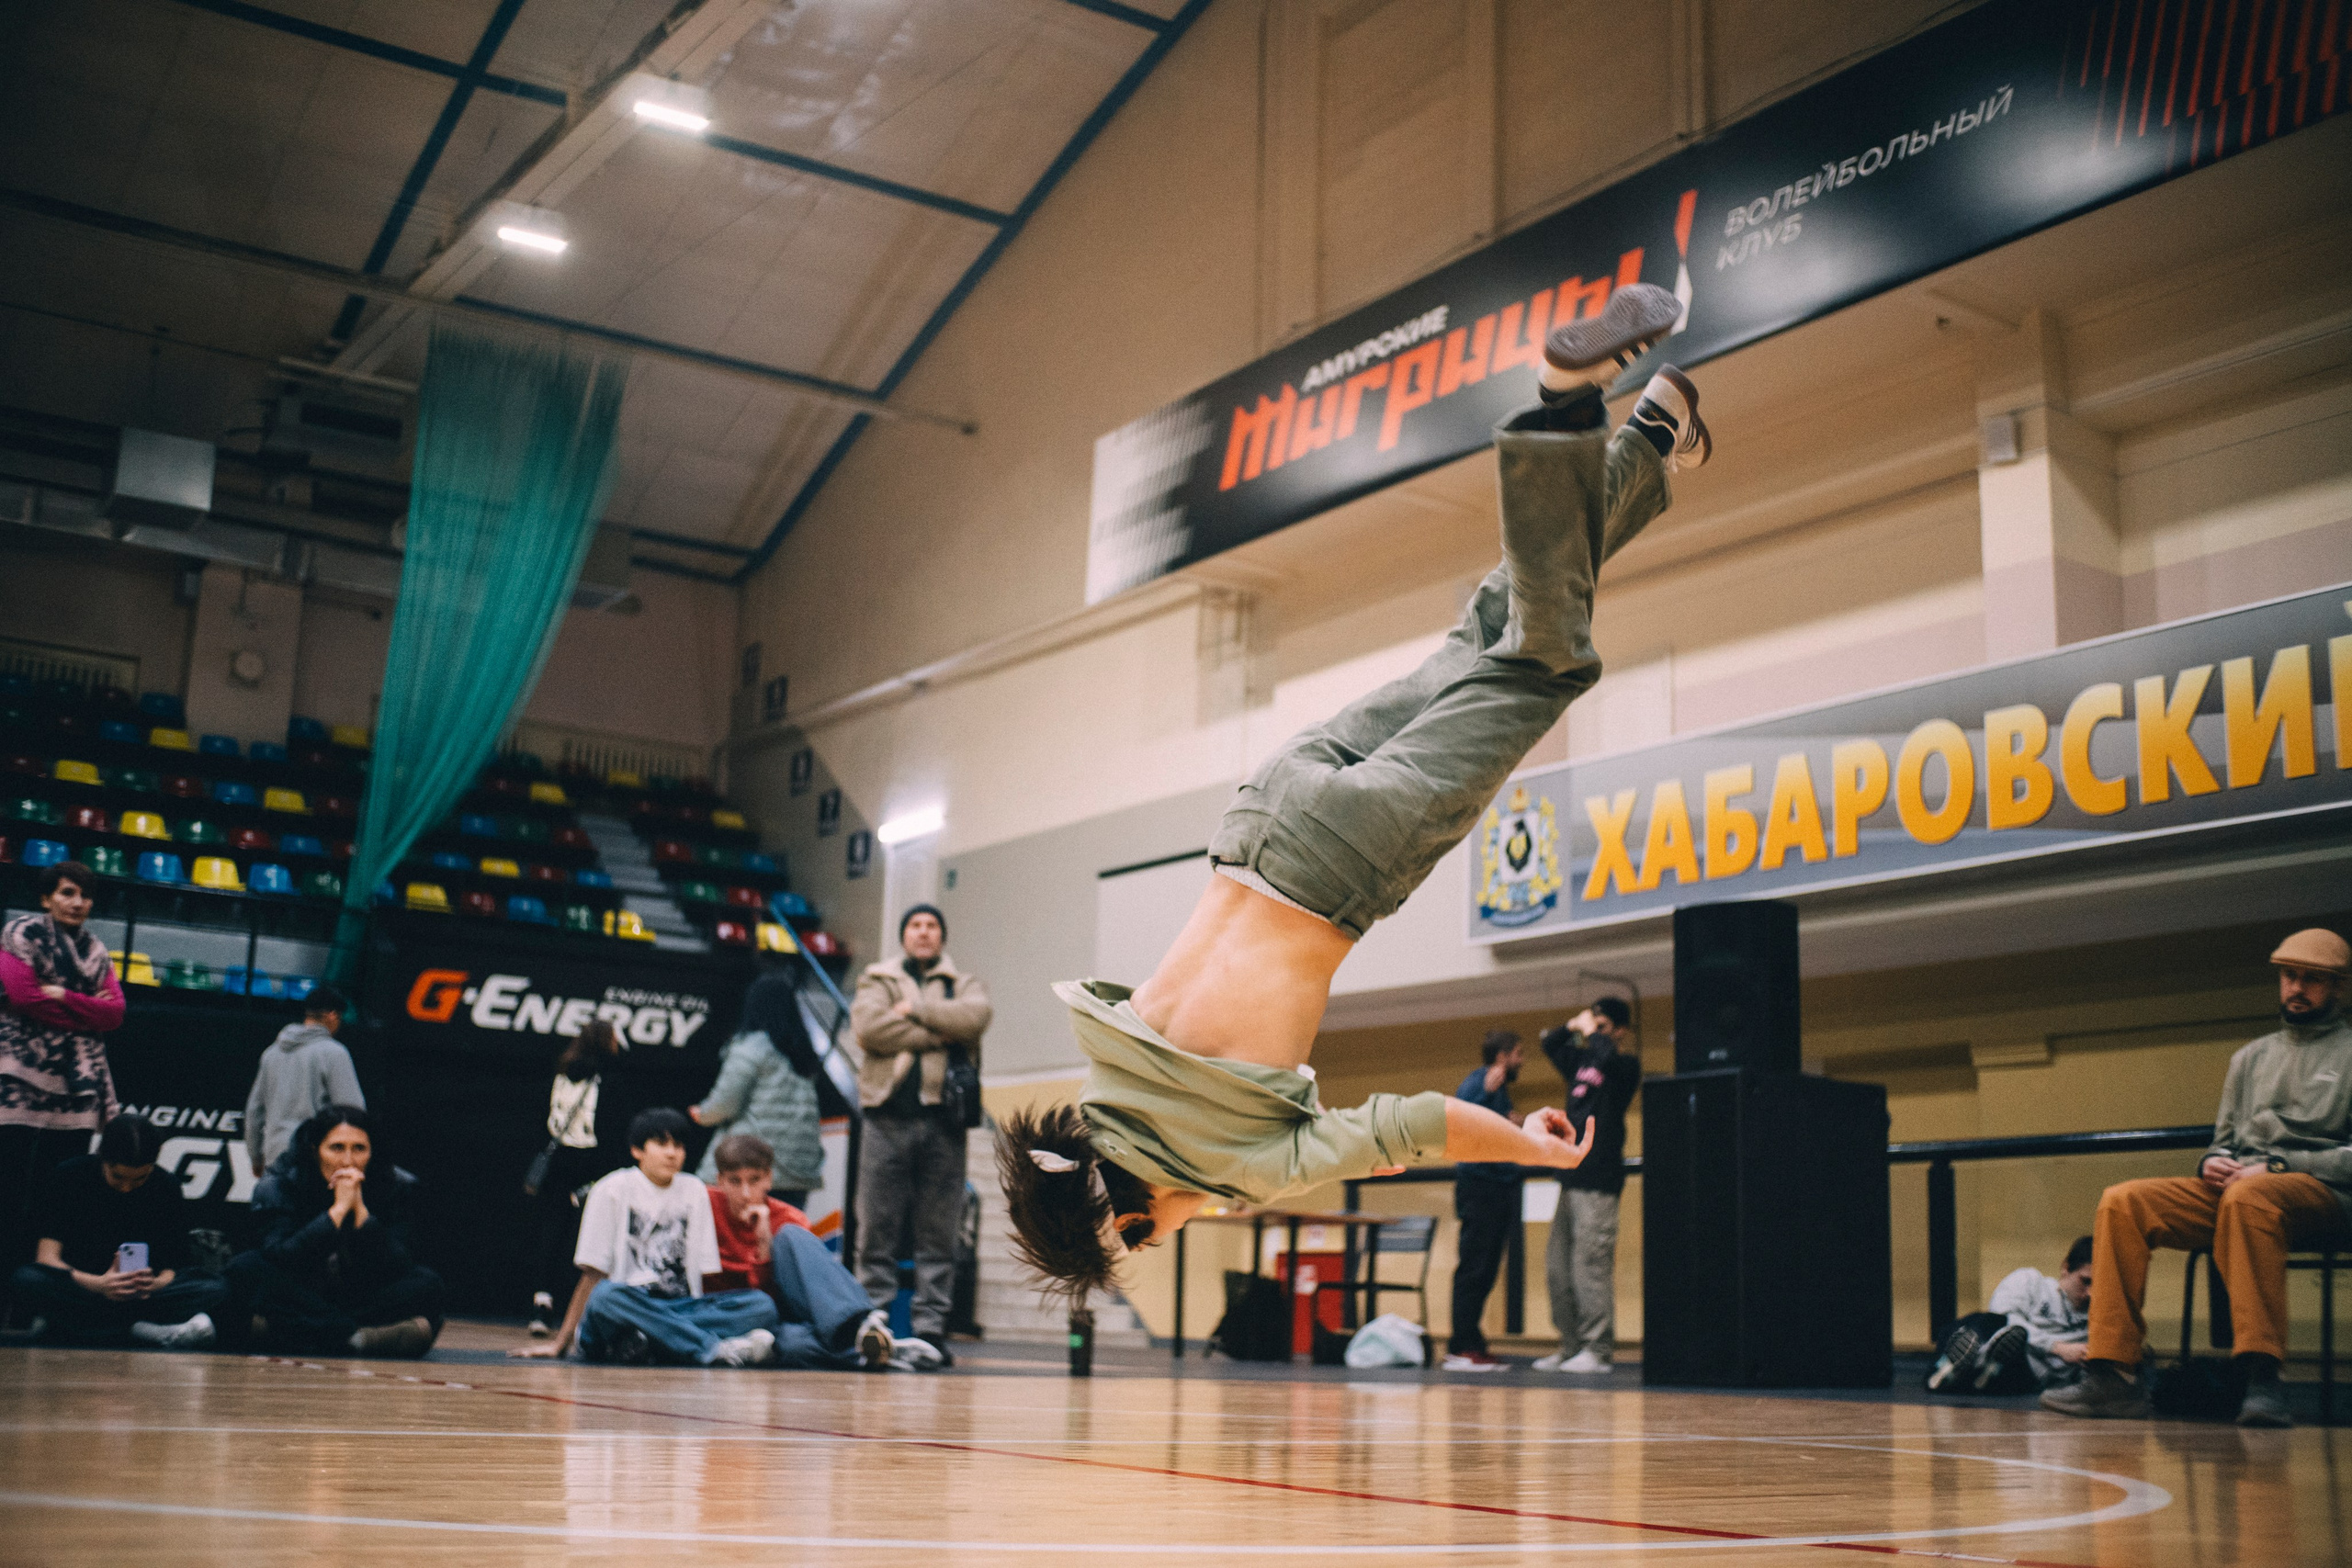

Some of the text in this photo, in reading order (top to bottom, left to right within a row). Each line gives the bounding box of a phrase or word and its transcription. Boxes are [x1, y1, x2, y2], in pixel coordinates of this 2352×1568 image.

[1724, 83, 2015, 239] ВОЛЕЙБОЛЬНЫЙ
[1714, 212, 1804, 271] КЛУБ
[1300, 303, 1450, 392] АМУРСКИЕ
[1581, 600, 2352, 902] ХАБАРОВСКИ
